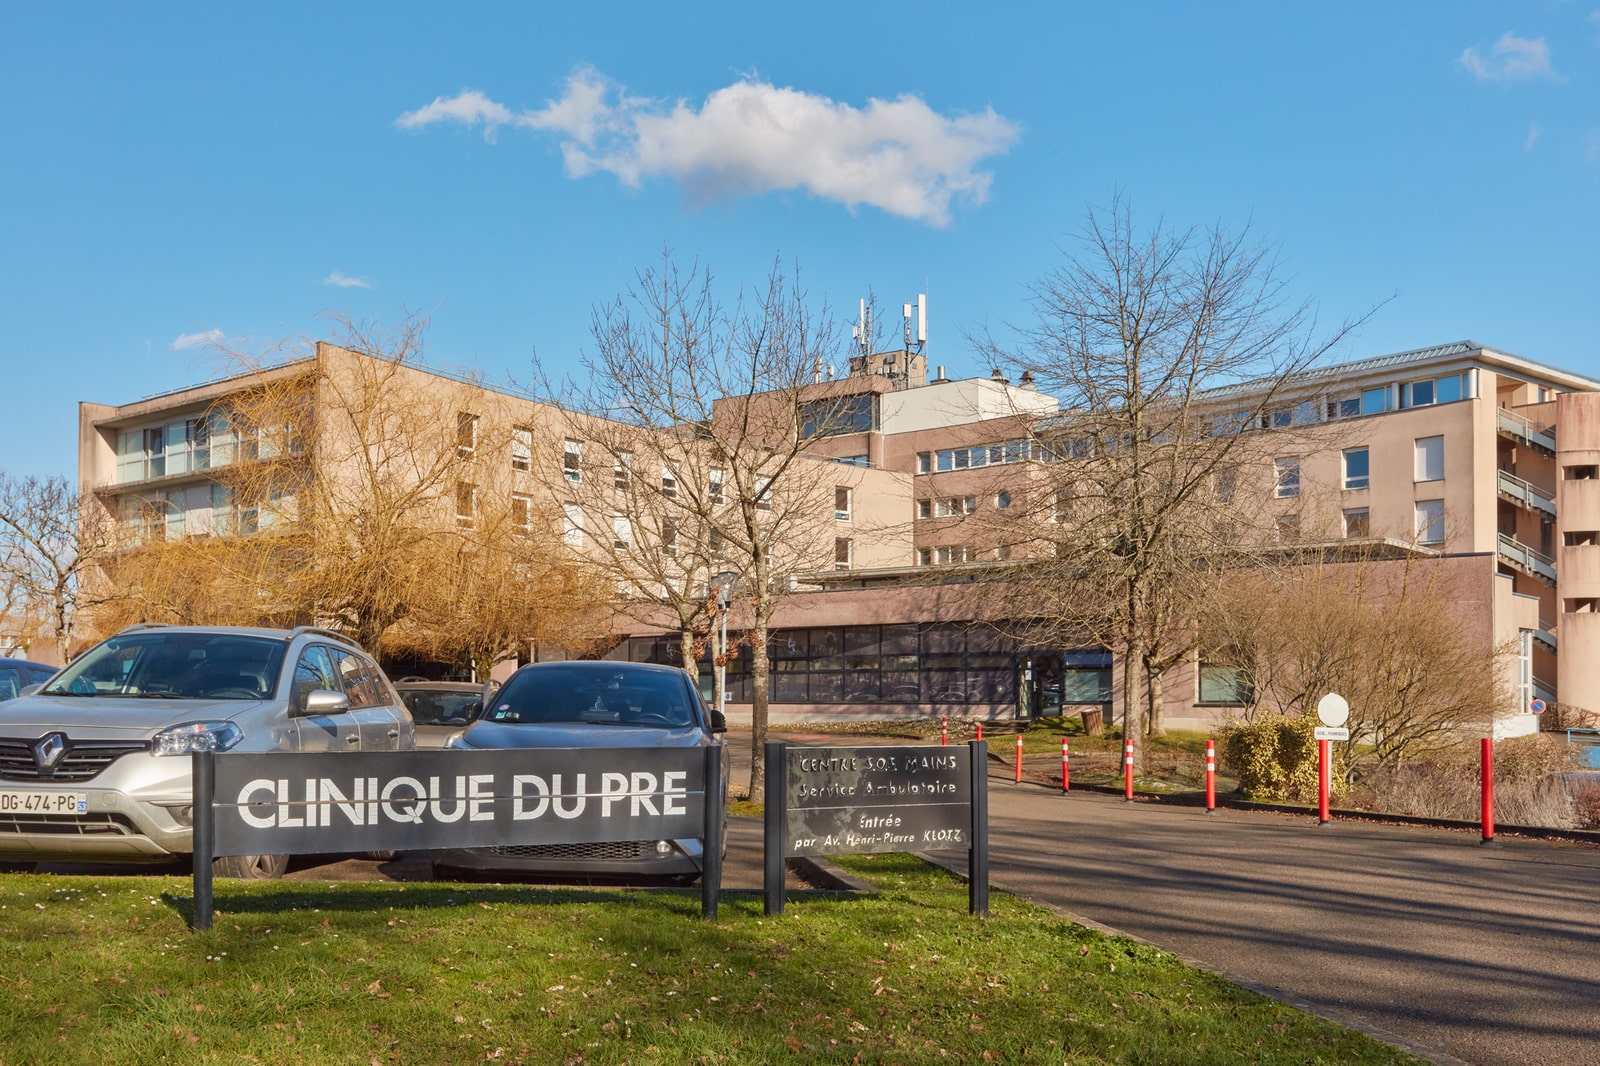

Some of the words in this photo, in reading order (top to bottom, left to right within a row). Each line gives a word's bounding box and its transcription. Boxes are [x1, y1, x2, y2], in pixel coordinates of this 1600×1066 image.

[800, 757, 857, 772] CENTRE
[905, 756, 957, 771] MAINS
[800, 784, 855, 798] Service
[1, 794, 76, 811] DG-474-PG
[237, 774, 495, 828] CLINIQUE
[513, 773, 586, 821] DU
[601, 771, 687, 818] PRE
[860, 814, 901, 829] Entrée
[795, 837, 816, 850] par
[824, 834, 841, 847] Av.
[846, 832, 915, 846] Henri-Pierre
[923, 829, 962, 843] KLOTZ
